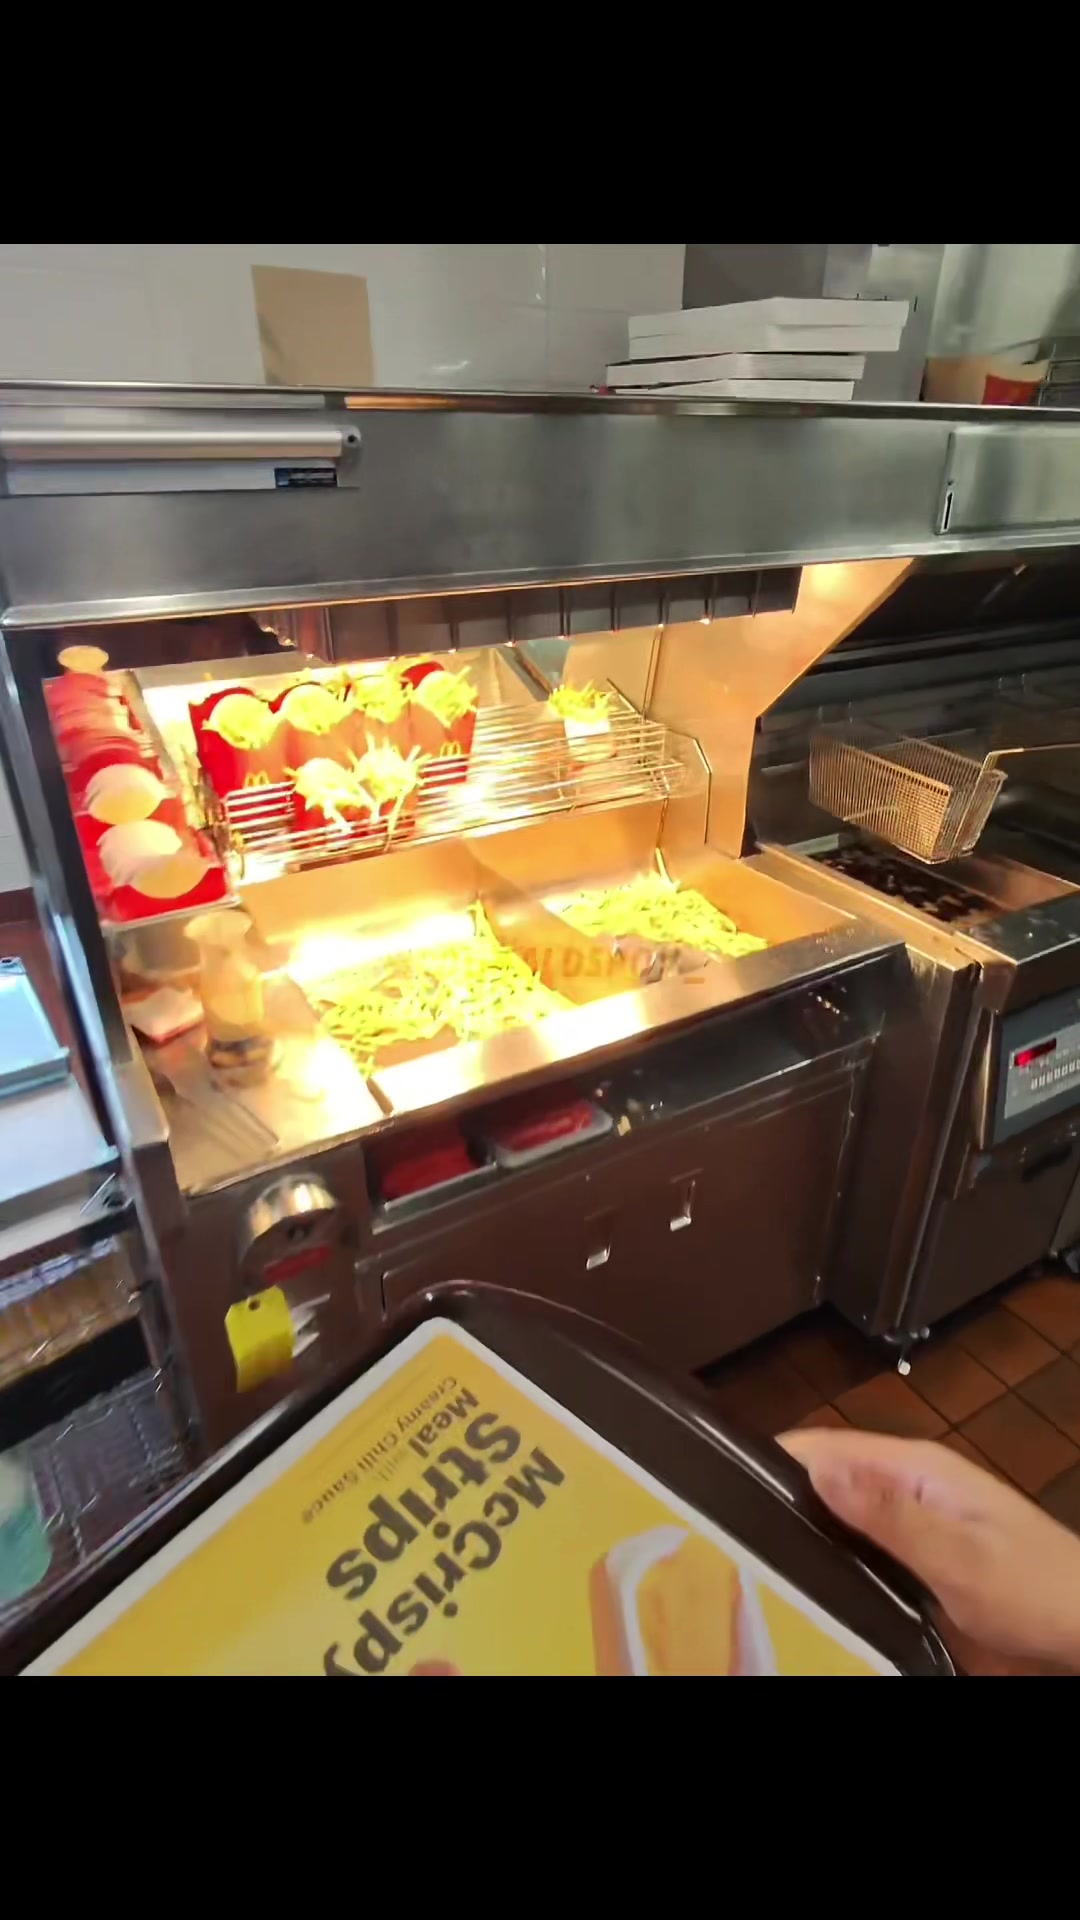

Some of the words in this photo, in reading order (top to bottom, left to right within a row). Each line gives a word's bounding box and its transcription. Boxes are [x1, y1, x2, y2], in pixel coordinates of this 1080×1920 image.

[396, 1376, 458, 1433] Creamy
[408, 1387, 479, 1459] Meal
[357, 1431, 399, 1471] Chilli
[302, 1470, 359, 1525] Sauce
[326, 1412, 521, 1601] Strips
